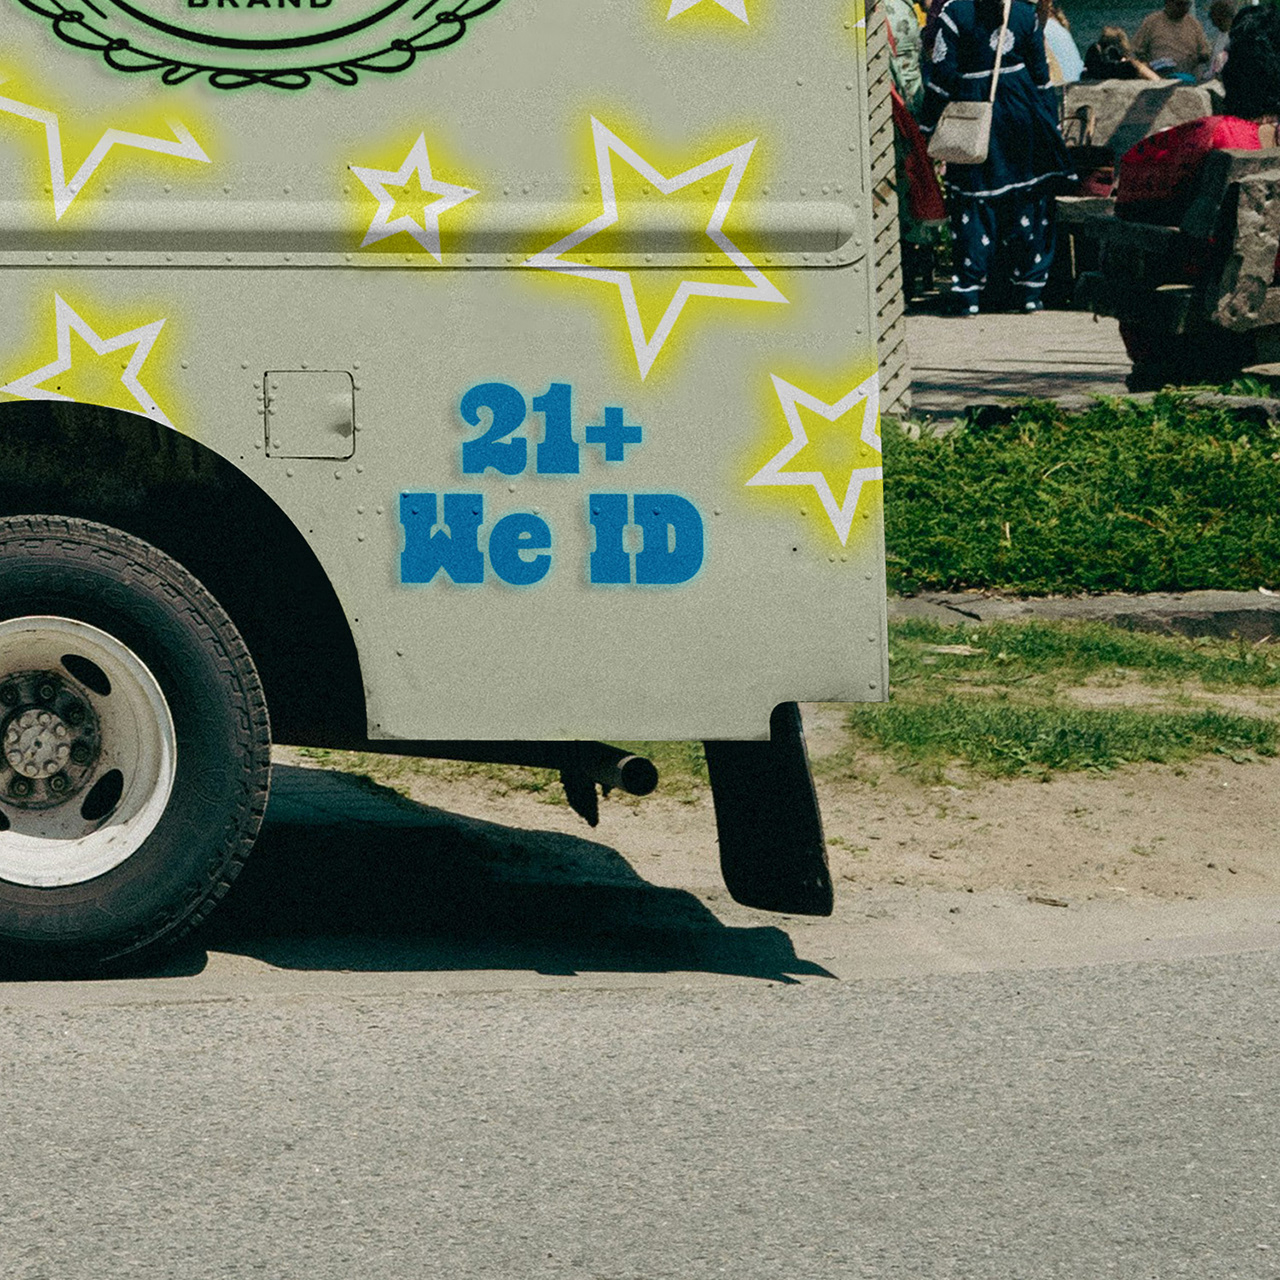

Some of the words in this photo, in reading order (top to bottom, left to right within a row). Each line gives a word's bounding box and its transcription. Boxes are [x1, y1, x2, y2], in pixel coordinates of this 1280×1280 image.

[458, 381, 644, 477] 21+
[397, 491, 553, 587] We
[587, 492, 705, 586] ID
